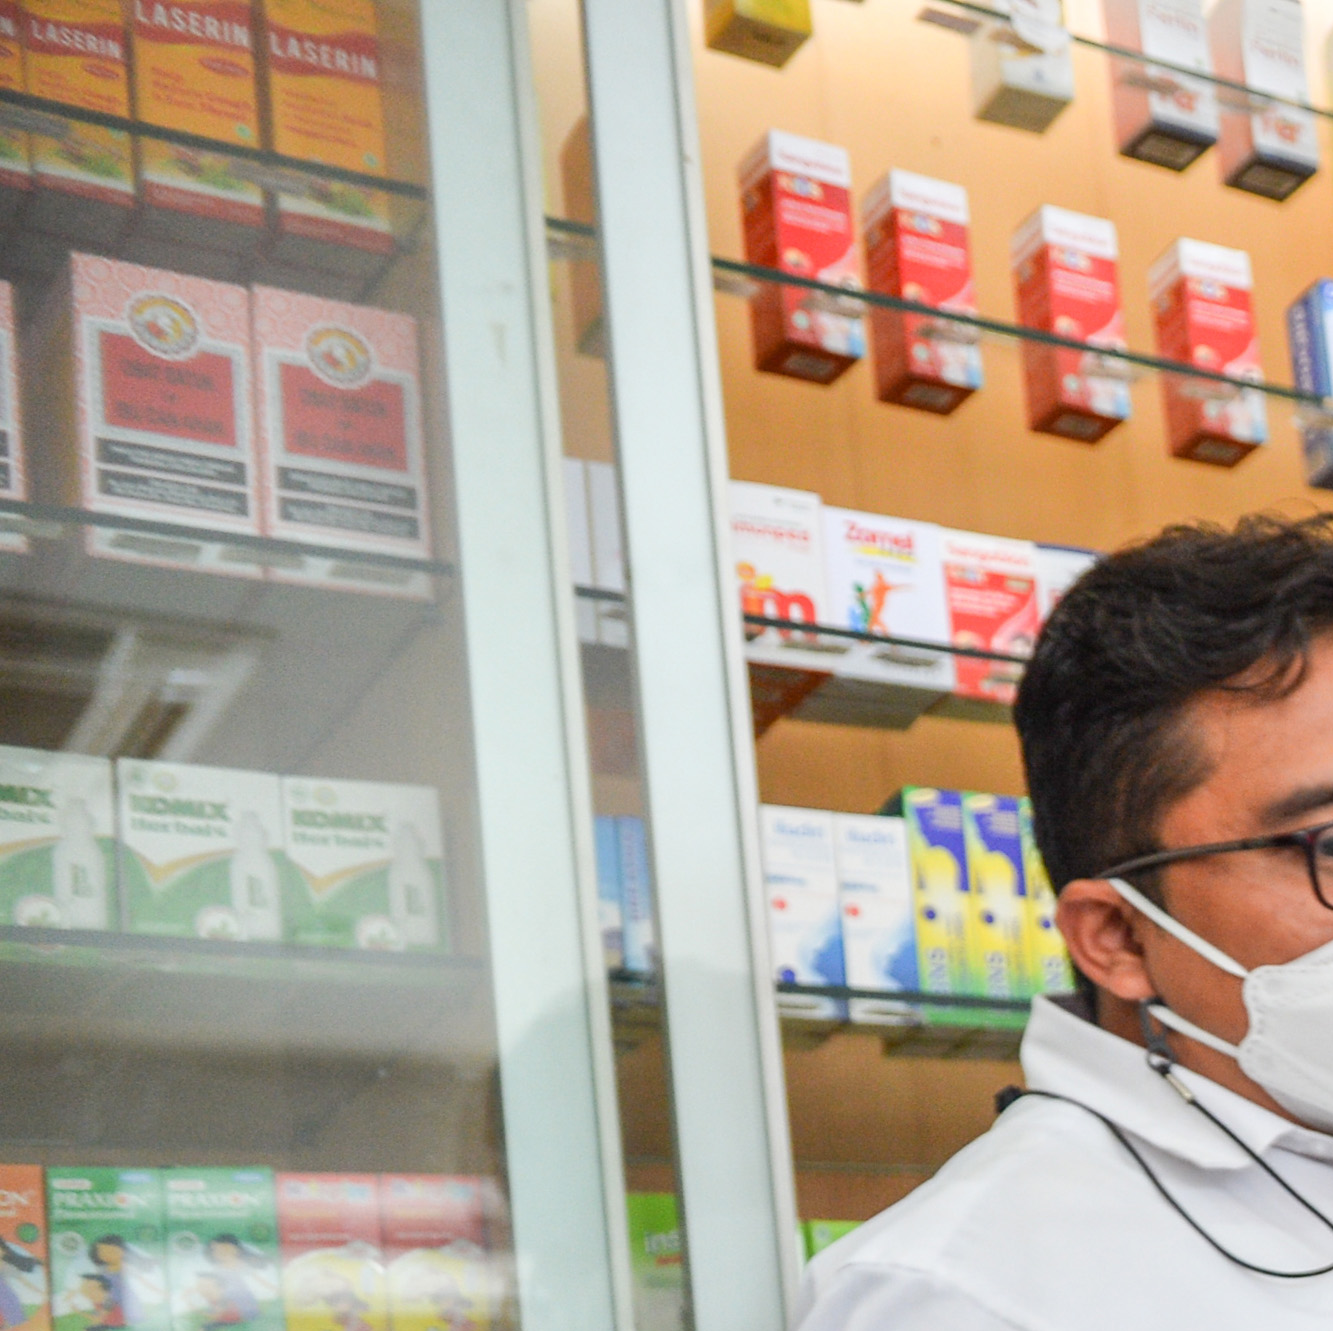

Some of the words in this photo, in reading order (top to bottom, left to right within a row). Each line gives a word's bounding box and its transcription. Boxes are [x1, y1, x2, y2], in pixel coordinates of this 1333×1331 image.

[31, 20, 121, 59] LASERIN
[135, 0, 250, 48] LASERIN
[269, 33, 379, 79] LASERIN
